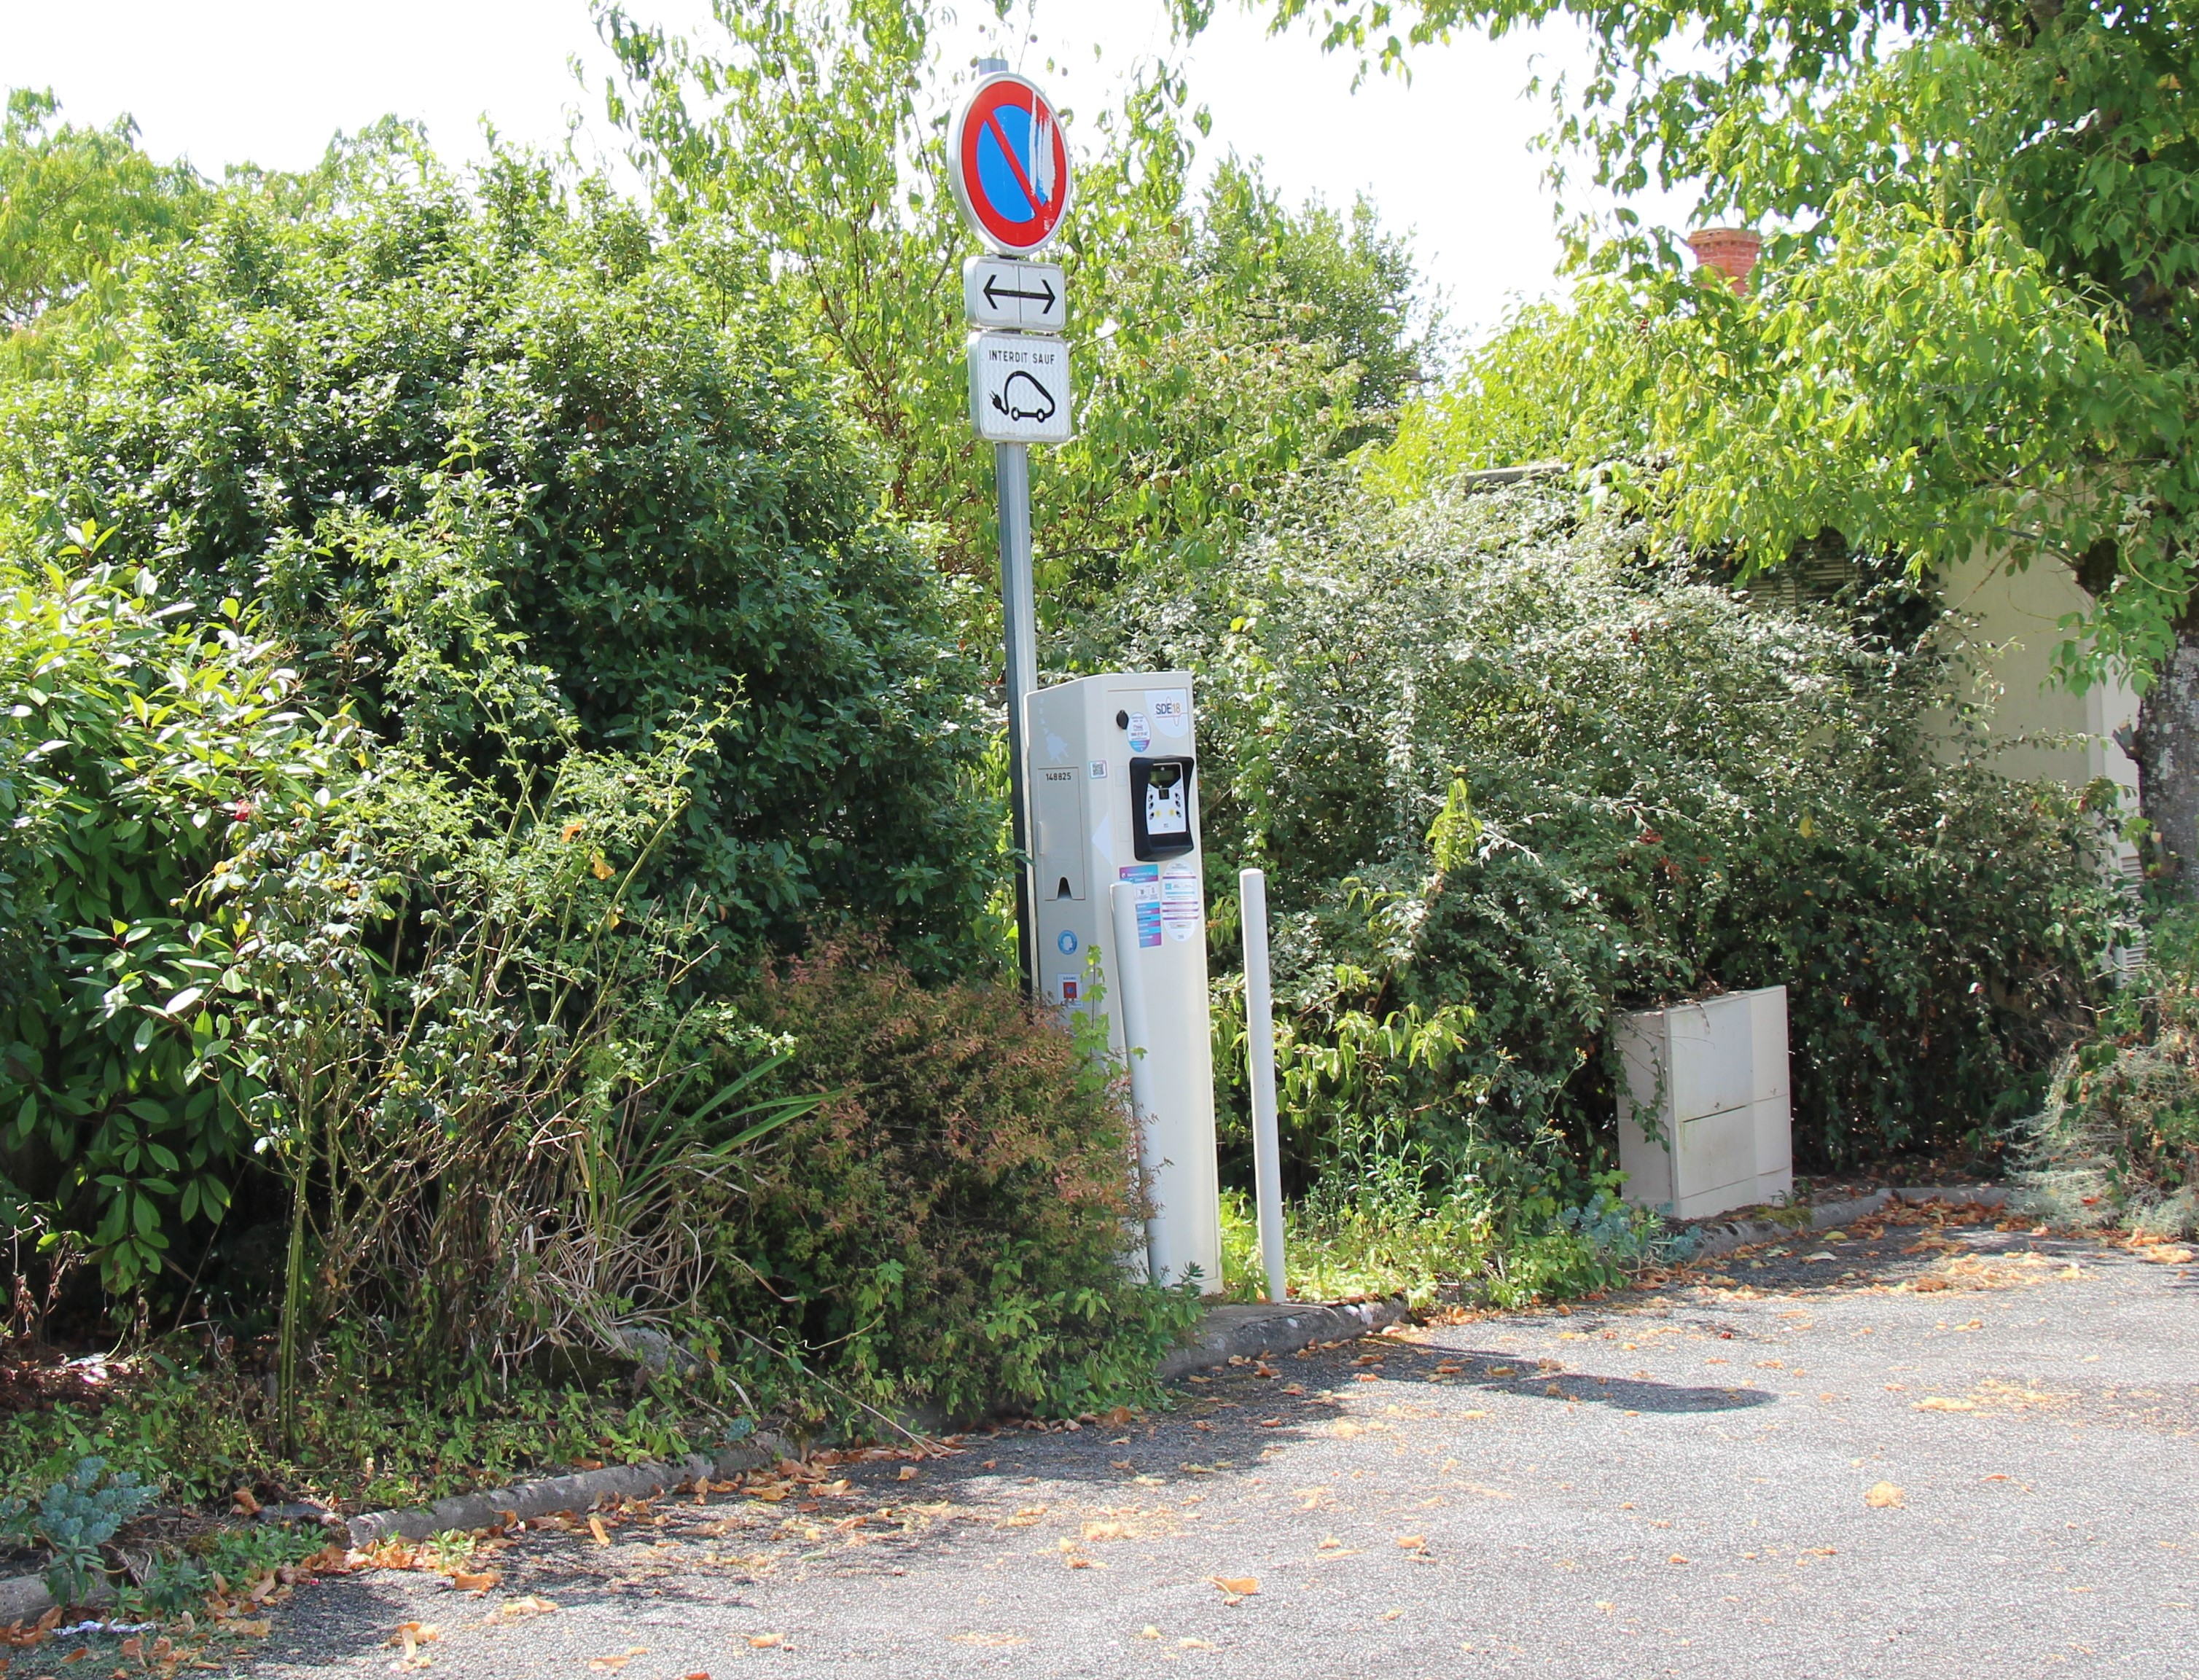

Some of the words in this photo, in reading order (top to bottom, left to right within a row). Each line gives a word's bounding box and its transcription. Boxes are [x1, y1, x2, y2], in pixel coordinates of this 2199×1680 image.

[989, 350, 1028, 363] INTERDIT
[1033, 353, 1055, 364] SAUF
[1155, 703, 1181, 714] SDE18
[1045, 773, 1071, 781] 148825
